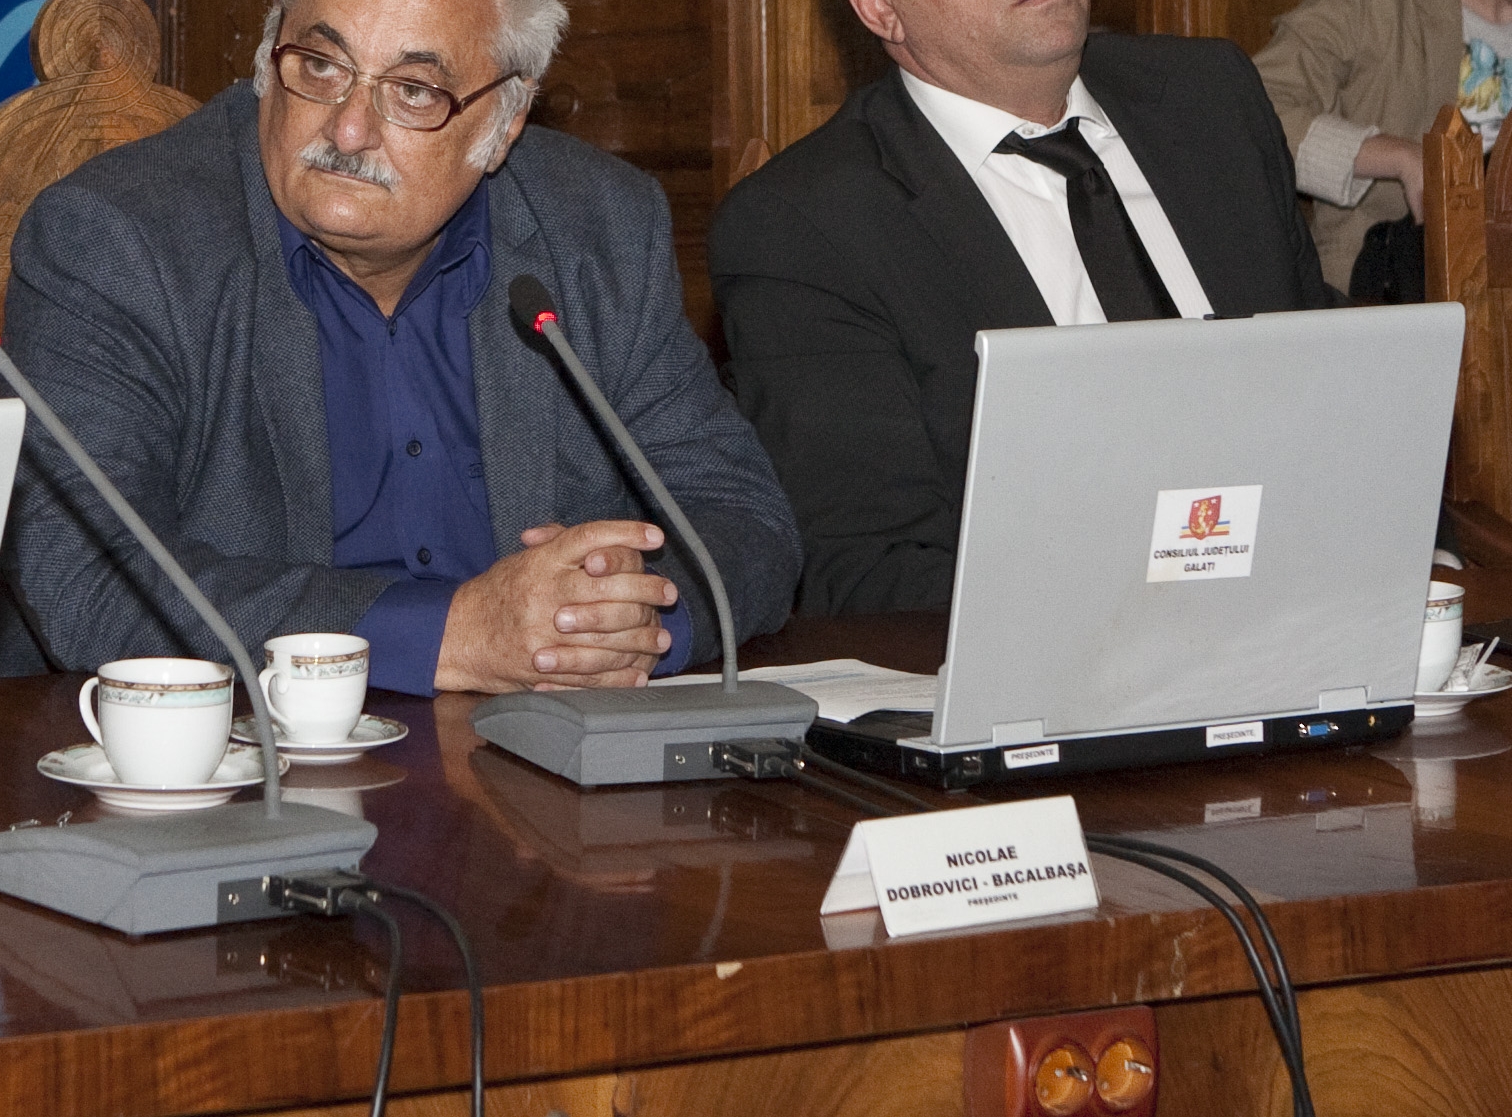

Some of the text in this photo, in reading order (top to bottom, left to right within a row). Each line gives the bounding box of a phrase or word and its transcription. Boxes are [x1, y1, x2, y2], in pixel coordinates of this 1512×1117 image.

[1153, 548, 1198, 560] CONSILIUL
[945, 845, 1018, 869] NICOLAE
[885, 876, 979, 903] DOBROVICI
